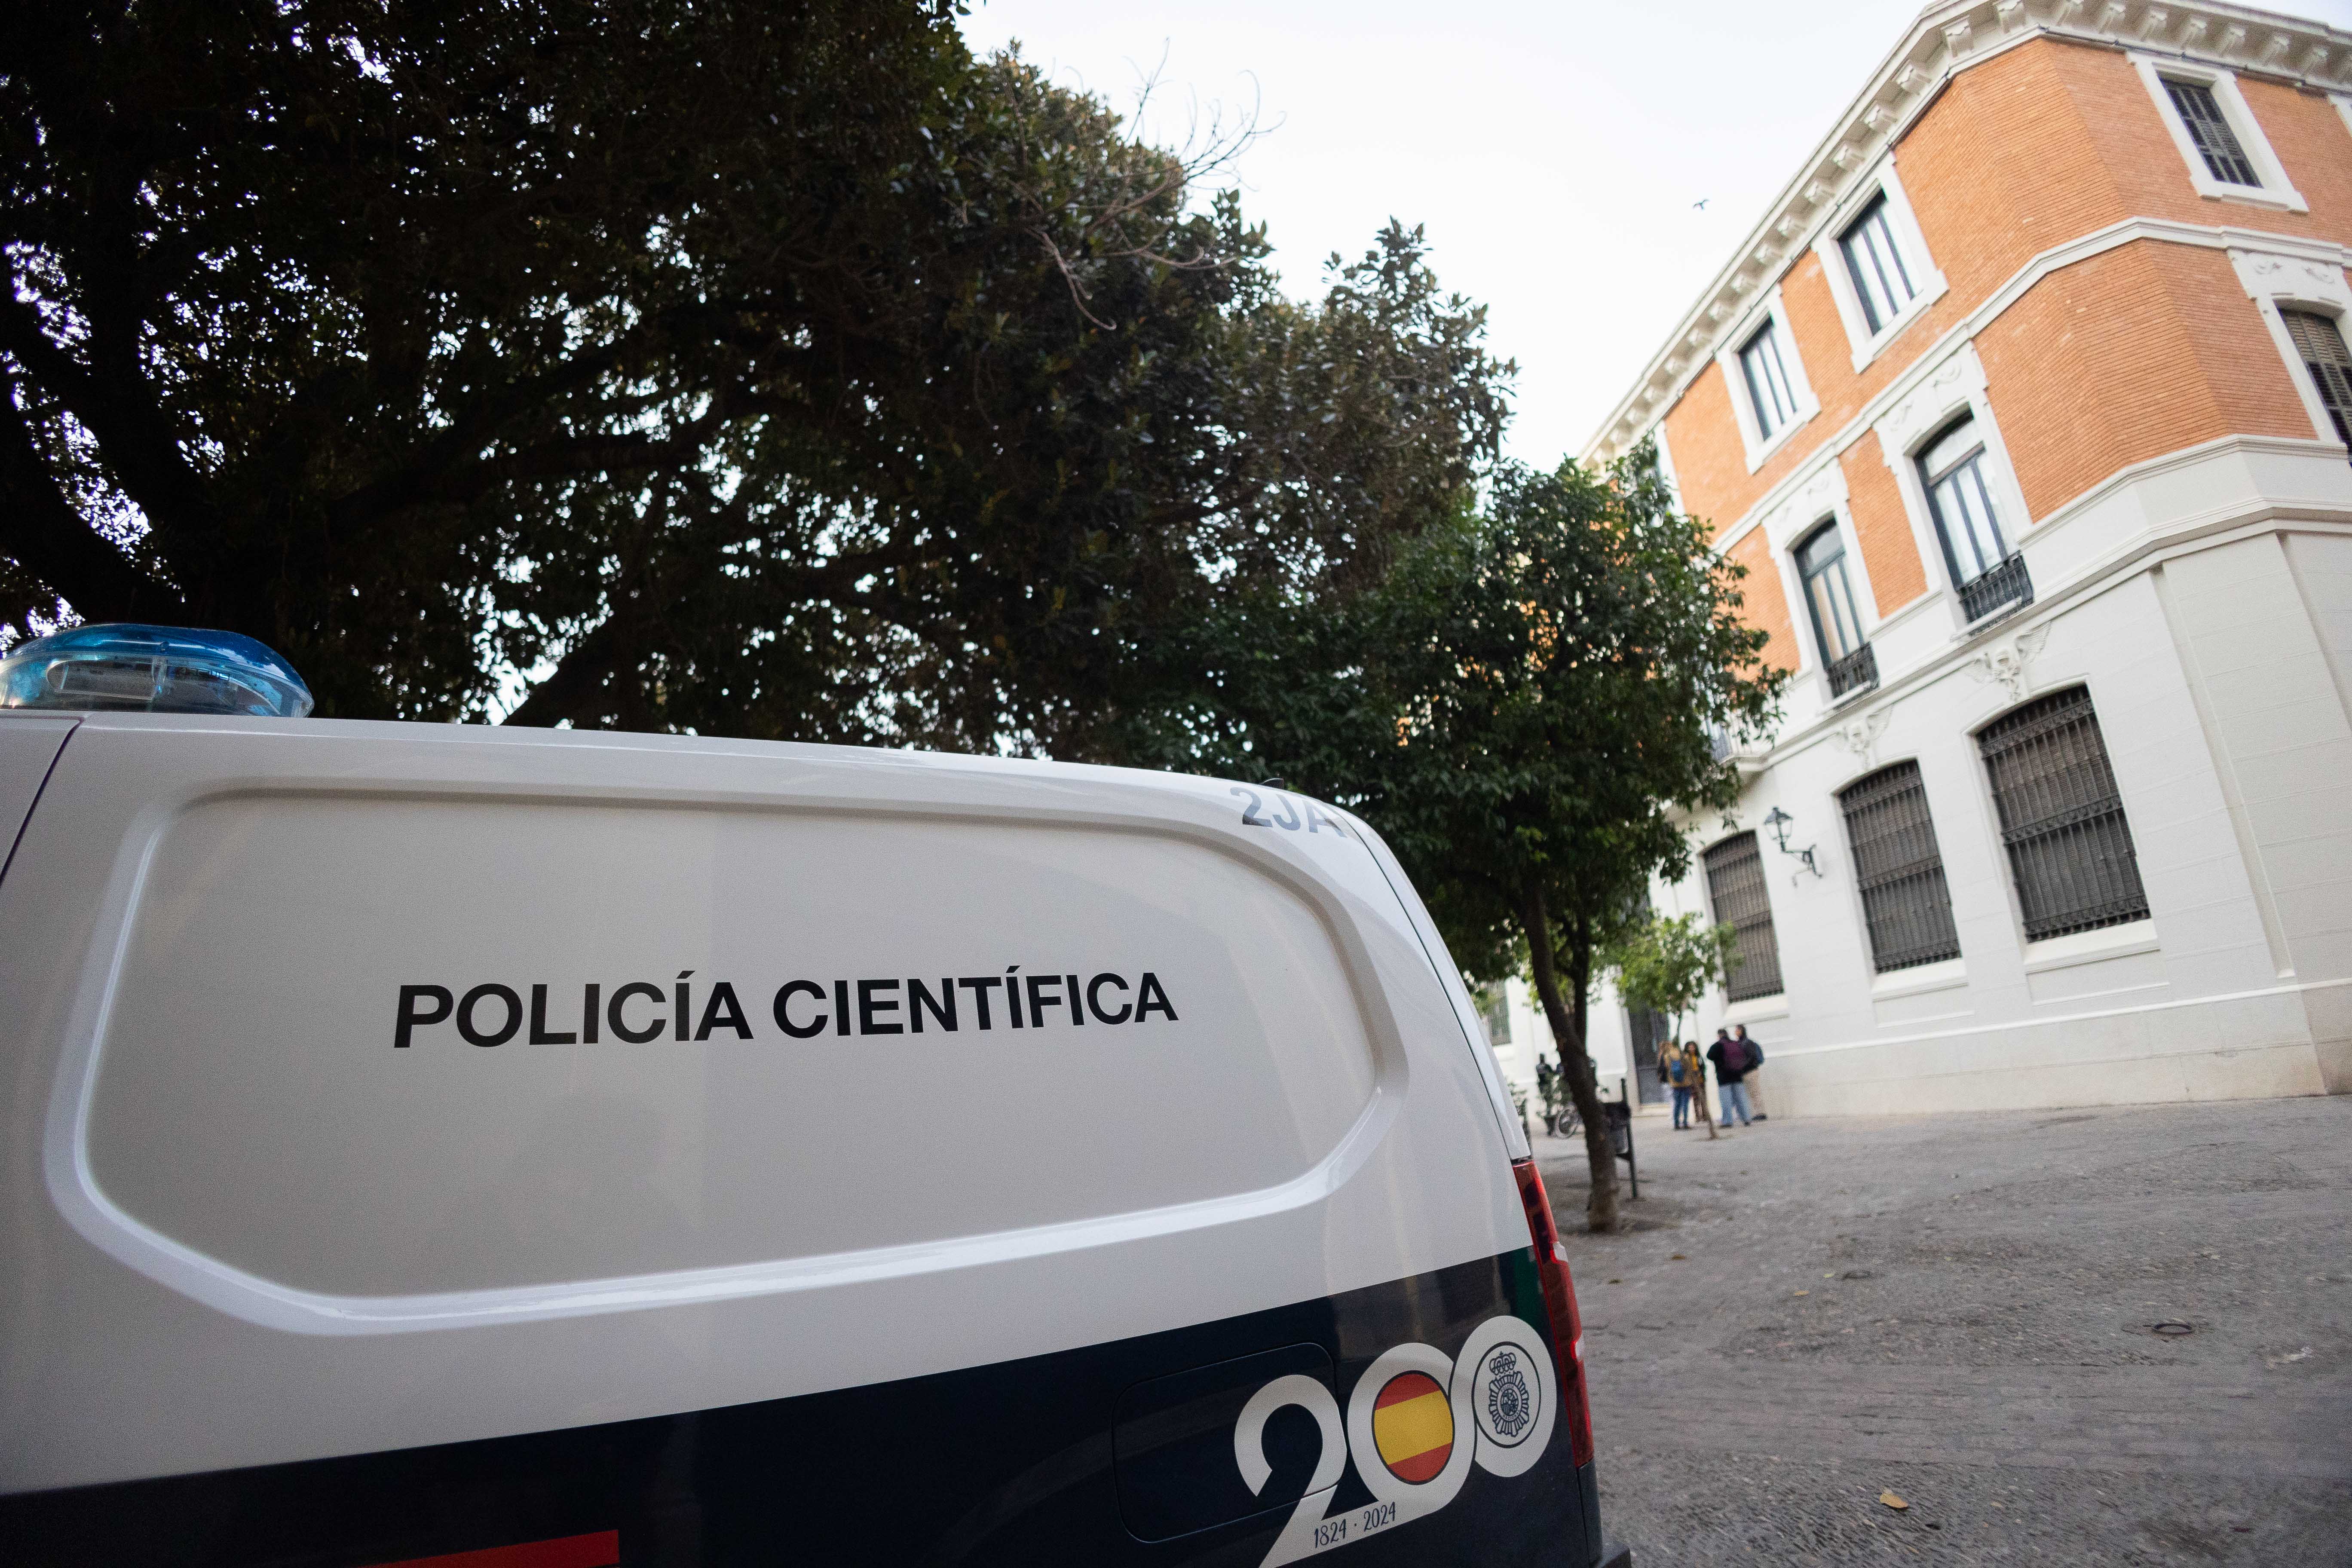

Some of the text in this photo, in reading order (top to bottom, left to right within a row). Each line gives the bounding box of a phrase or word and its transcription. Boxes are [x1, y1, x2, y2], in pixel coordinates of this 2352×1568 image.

[1230, 787, 1348, 839] 2JA
[393, 965, 1179, 1049] POLICÍA CIENTÍFICA
[1234, 1315, 1557, 1568] 200
[1314, 1519, 1346, 1548] 1824
[1364, 1501, 1396, 1531] 2024
